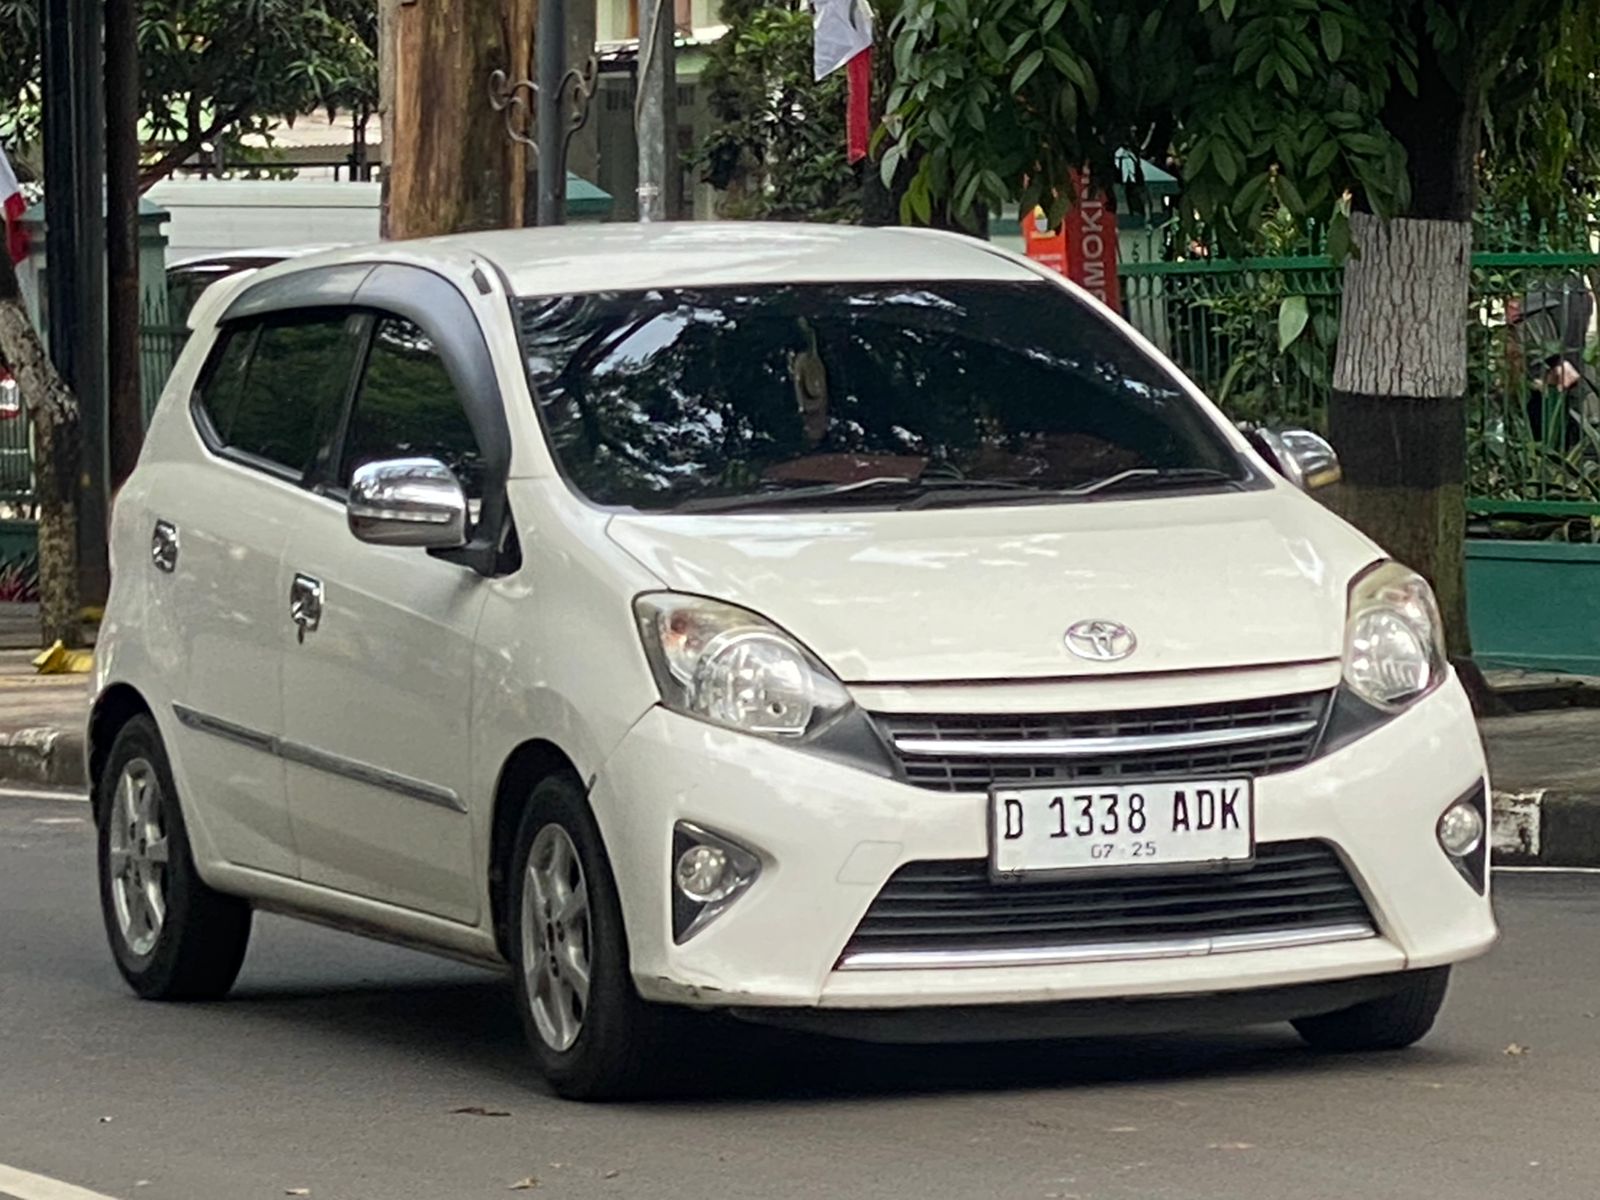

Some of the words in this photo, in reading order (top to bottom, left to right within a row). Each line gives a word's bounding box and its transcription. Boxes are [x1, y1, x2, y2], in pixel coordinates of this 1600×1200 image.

[1081, 164, 1106, 303] MOKI
[1004, 799, 1023, 839] D
[1049, 793, 1146, 838] 1338
[1172, 787, 1240, 831] ADK
